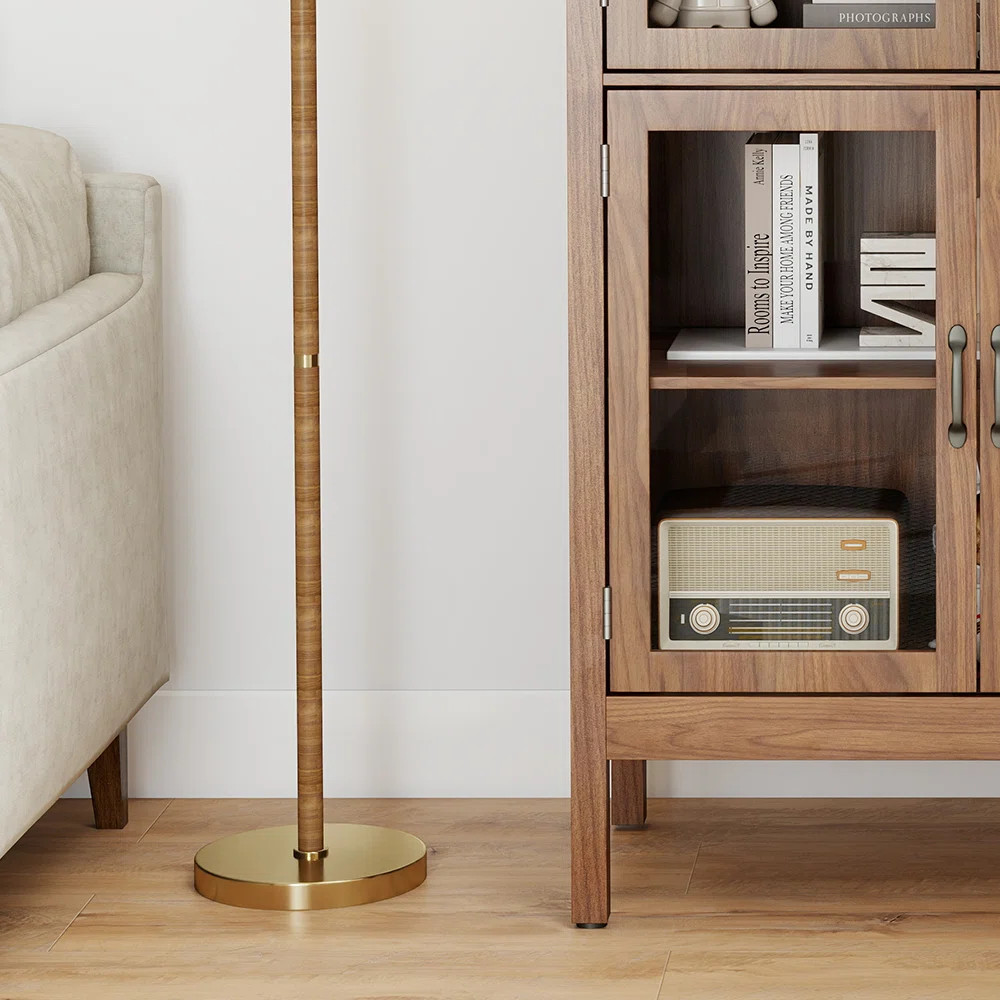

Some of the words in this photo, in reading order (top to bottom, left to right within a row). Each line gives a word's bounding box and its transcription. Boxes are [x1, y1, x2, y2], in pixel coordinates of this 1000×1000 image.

[839, 12, 931, 23] PHOTOGRAPHS
[752, 148, 768, 165] Kelly
[753, 167, 765, 186] Annie
[780, 174, 794, 210] FRIENDS
[805, 185, 814, 224] MADE
[780, 212, 794, 245] AMONG
[805, 230, 814, 247] BY
[747, 233, 773, 274] Inspire
[780, 246, 794, 272] HOME
[750, 278, 770, 290] to
[805, 252, 814, 291] HAND
[780, 274, 794, 298] YOUR
[748, 293, 770, 335] Rooms
[780, 300, 794, 324] MAKE
